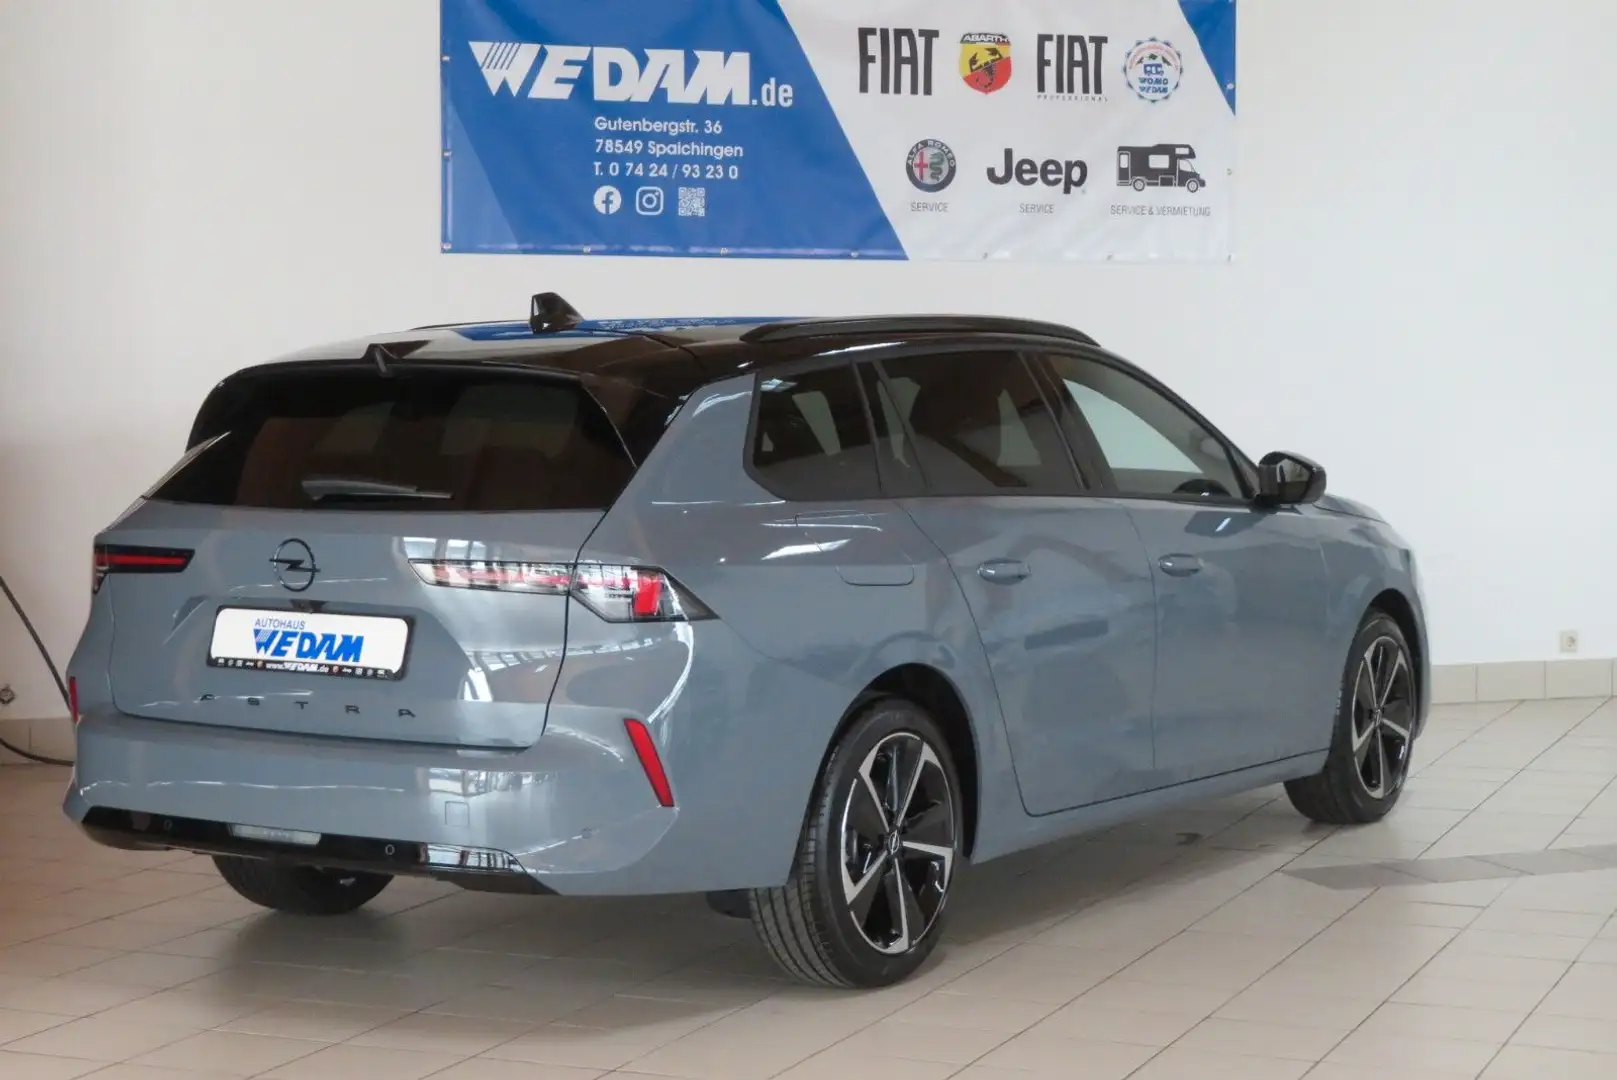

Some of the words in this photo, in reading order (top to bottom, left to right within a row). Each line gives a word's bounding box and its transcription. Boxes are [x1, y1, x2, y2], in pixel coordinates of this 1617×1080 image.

[963, 33, 1010, 43] ABARTH
[858, 27, 940, 96] FIAT
[1036, 33, 1108, 95] FIAT
[1139, 77, 1169, 85] WOMO
[594, 116, 699, 136] Gutenbergstr.
[704, 120, 723, 134] 36
[595, 139, 643, 154] 78549
[647, 141, 744, 158] Spaichingen
[907, 143, 925, 166] ALFA
[593, 161, 604, 176] T.
[609, 162, 619, 176] 0
[625, 162, 644, 177] 74
[648, 162, 668, 177] 24
[671, 164, 678, 179] /
[682, 164, 700, 179] 93
[705, 165, 724, 179] 23
[728, 165, 739, 180] 0
[986, 148, 1088, 194] Jeep
[910, 201, 949, 213] SERVICE
[1019, 203, 1054, 214] SERVICE
[1110, 204, 1146, 216] SERVICE
[1147, 206, 1154, 216] &
[1156, 206, 1211, 217] VERMIETUNG
[254, 617, 306, 630] AUTOHAUS
[253, 628, 365, 663] WEDAM
